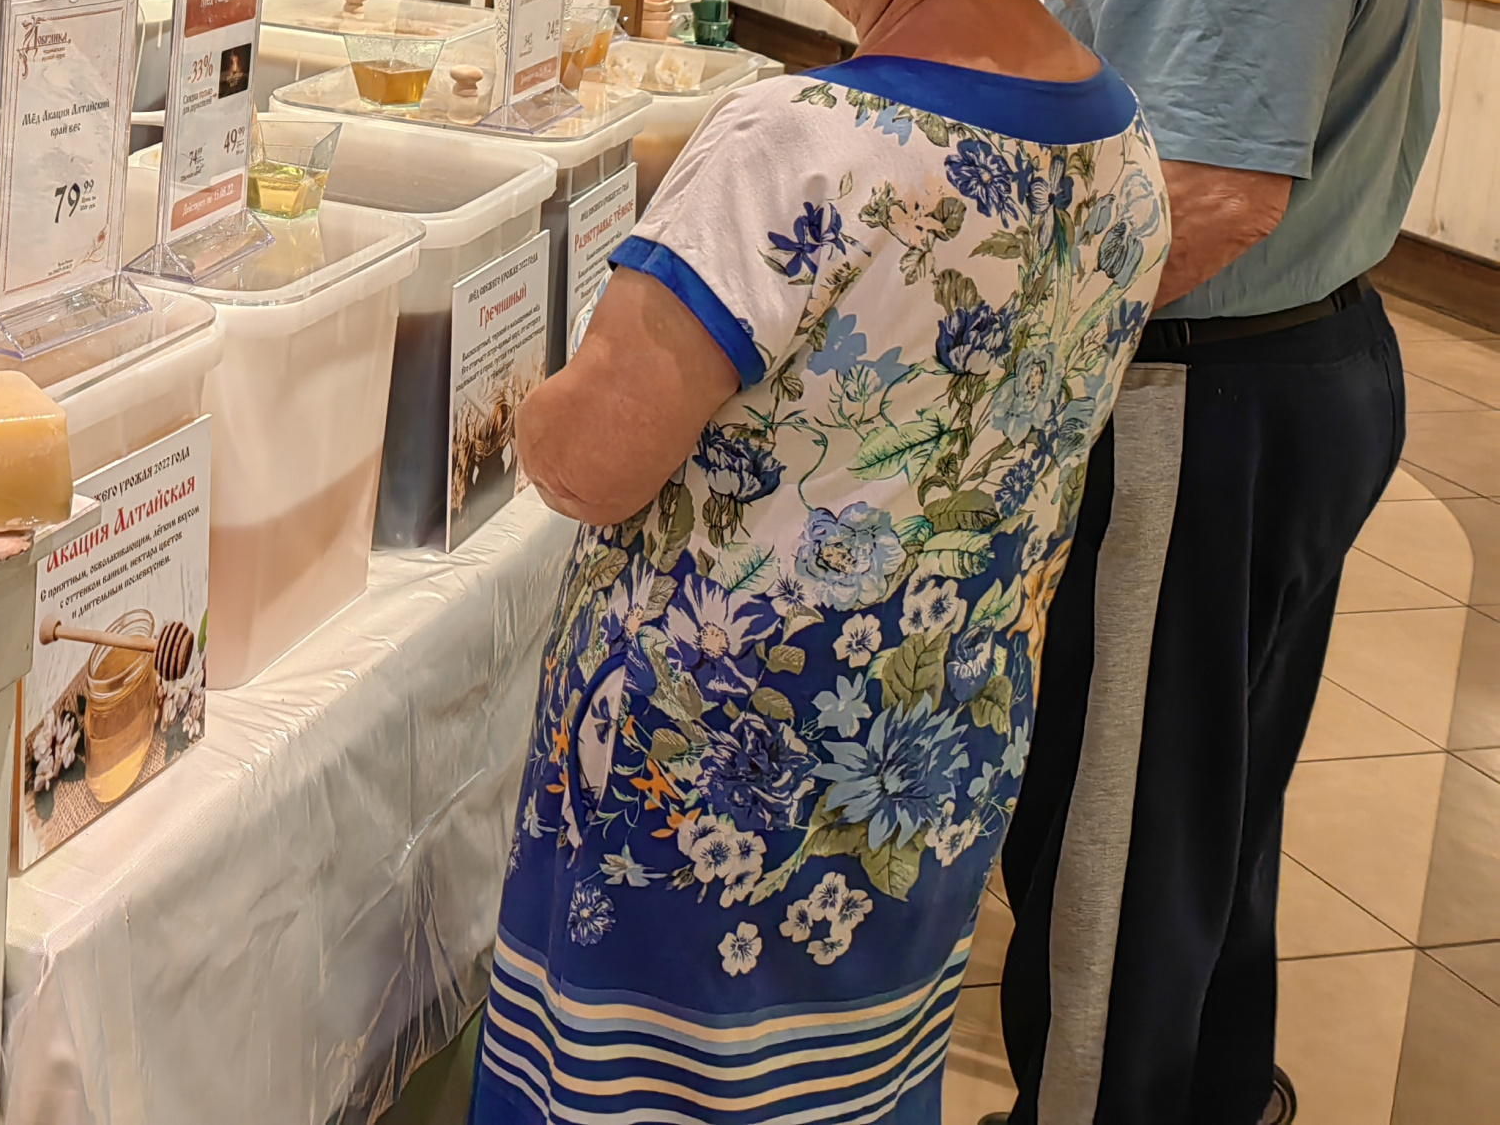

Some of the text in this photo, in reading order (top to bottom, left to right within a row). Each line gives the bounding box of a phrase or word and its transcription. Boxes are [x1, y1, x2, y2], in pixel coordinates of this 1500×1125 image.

[187, 52, 214, 84] -33%
[22, 98, 110, 126] Мёд Акация Алтайский
[50, 123, 81, 139] край вес
[224, 129, 237, 153] 49
[54, 179, 95, 223] 79 99
[479, 282, 527, 330] Гречишный
[153, 457, 170, 475] 2022
[46, 475, 196, 573] Акация Алтайская
[48, 570, 88, 599] приятным,
[89, 532, 152, 574] обволакивающим,
[153, 519, 176, 539] лёгким
[177, 505, 200, 526] вкусом
[60, 531, 183, 609] с оттенком ванили, нектара цветов
[71, 557, 171, 619] и длительным послевкусием.
